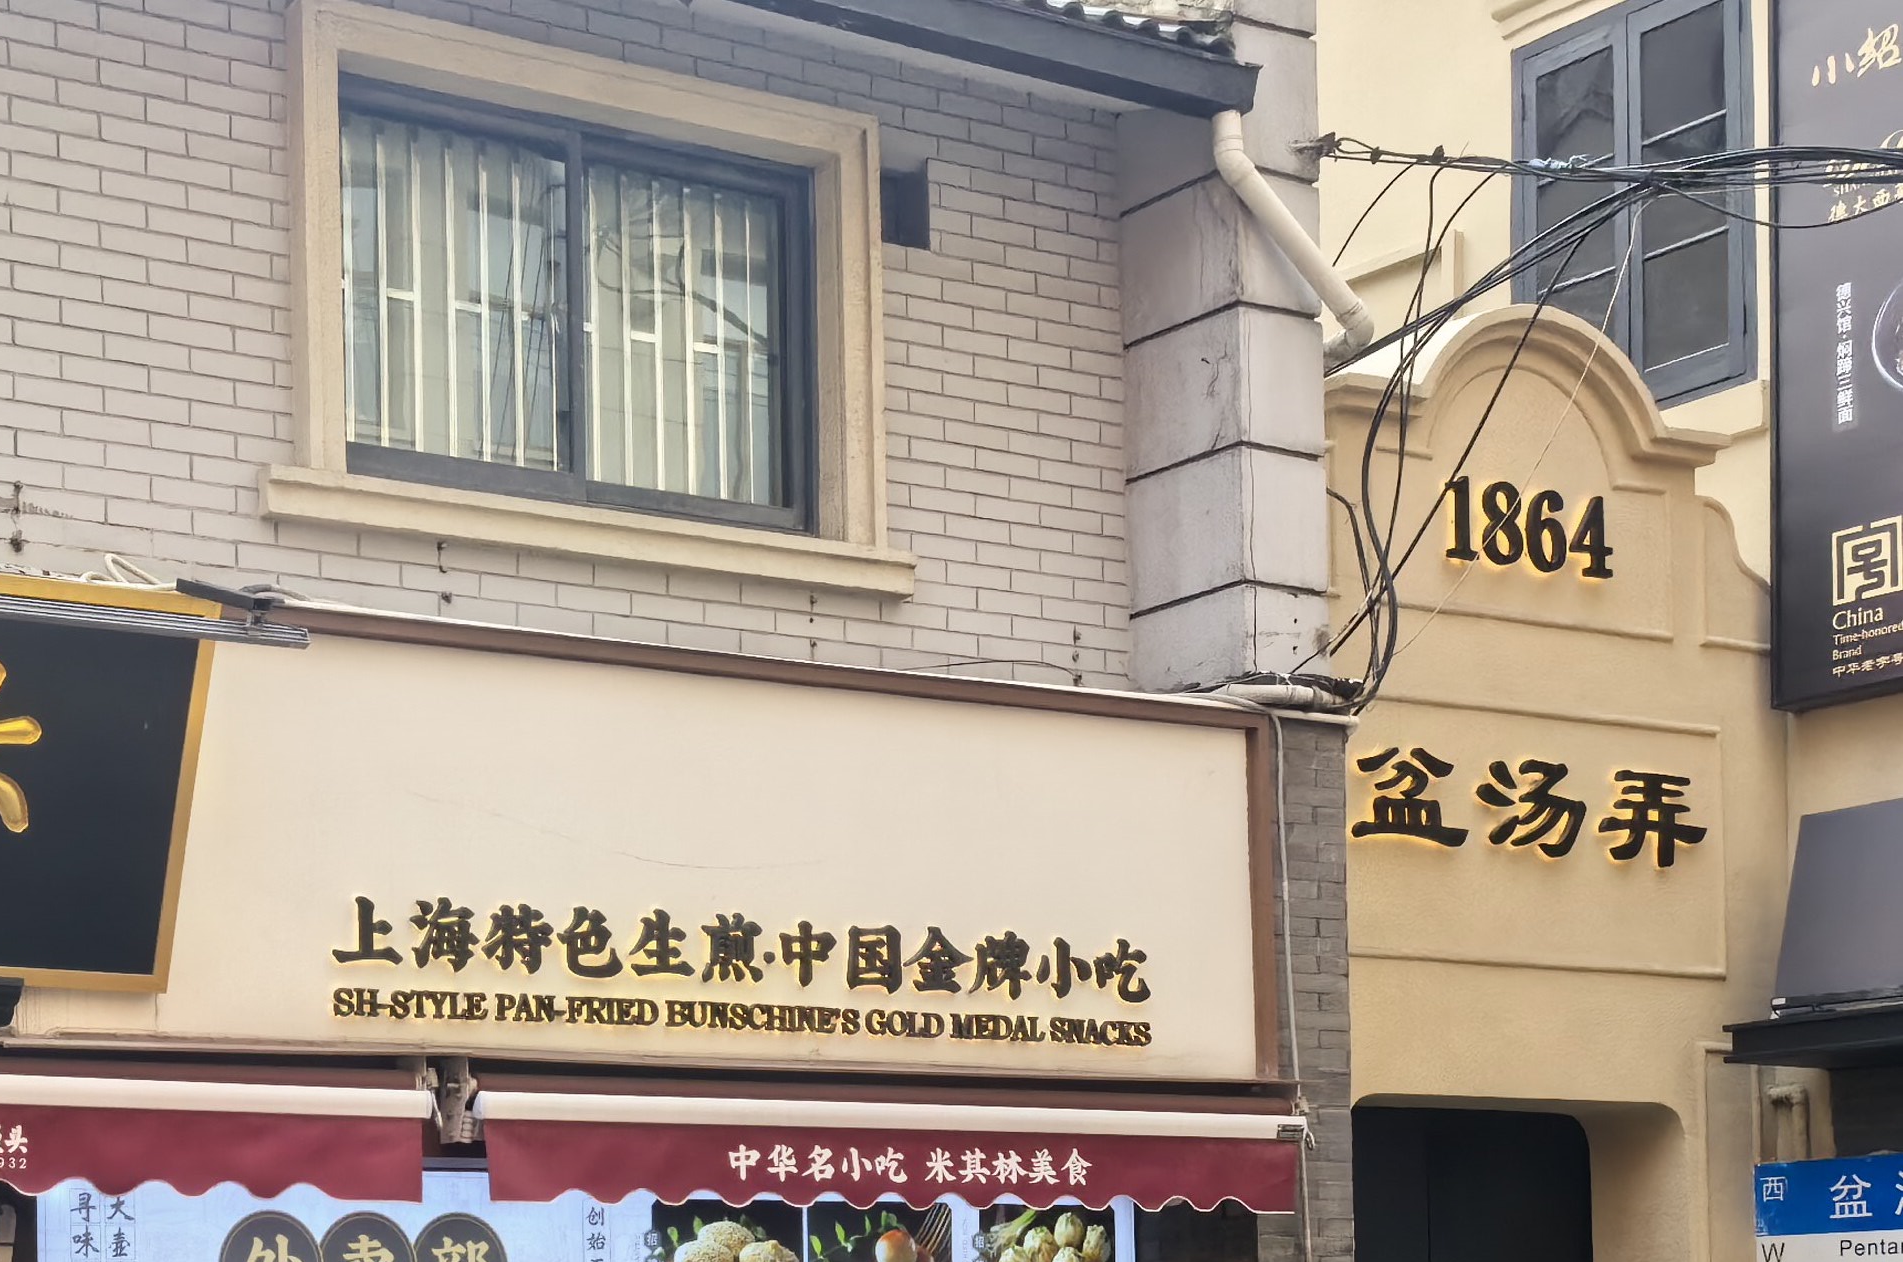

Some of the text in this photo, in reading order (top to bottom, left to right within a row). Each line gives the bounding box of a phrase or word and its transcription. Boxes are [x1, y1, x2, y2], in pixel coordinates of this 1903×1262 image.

[1443, 474, 1614, 580] 1864
[1832, 606, 1884, 630] China
[1832, 644, 1863, 661] Brand
[1350, 746, 1708, 868] 盆汤弄
[332, 987, 489, 1021] SH-STYLE
[494, 993, 660, 1027] PAN-FRIED
[864, 1008, 945, 1039] GOLD
[949, 1012, 1047, 1043] MEDAL
[1049, 1016, 1153, 1047] SNACKS
[727, 1143, 1093, 1186] 中华名小吃 米其林美食
[1759, 1176, 1788, 1203] 西
